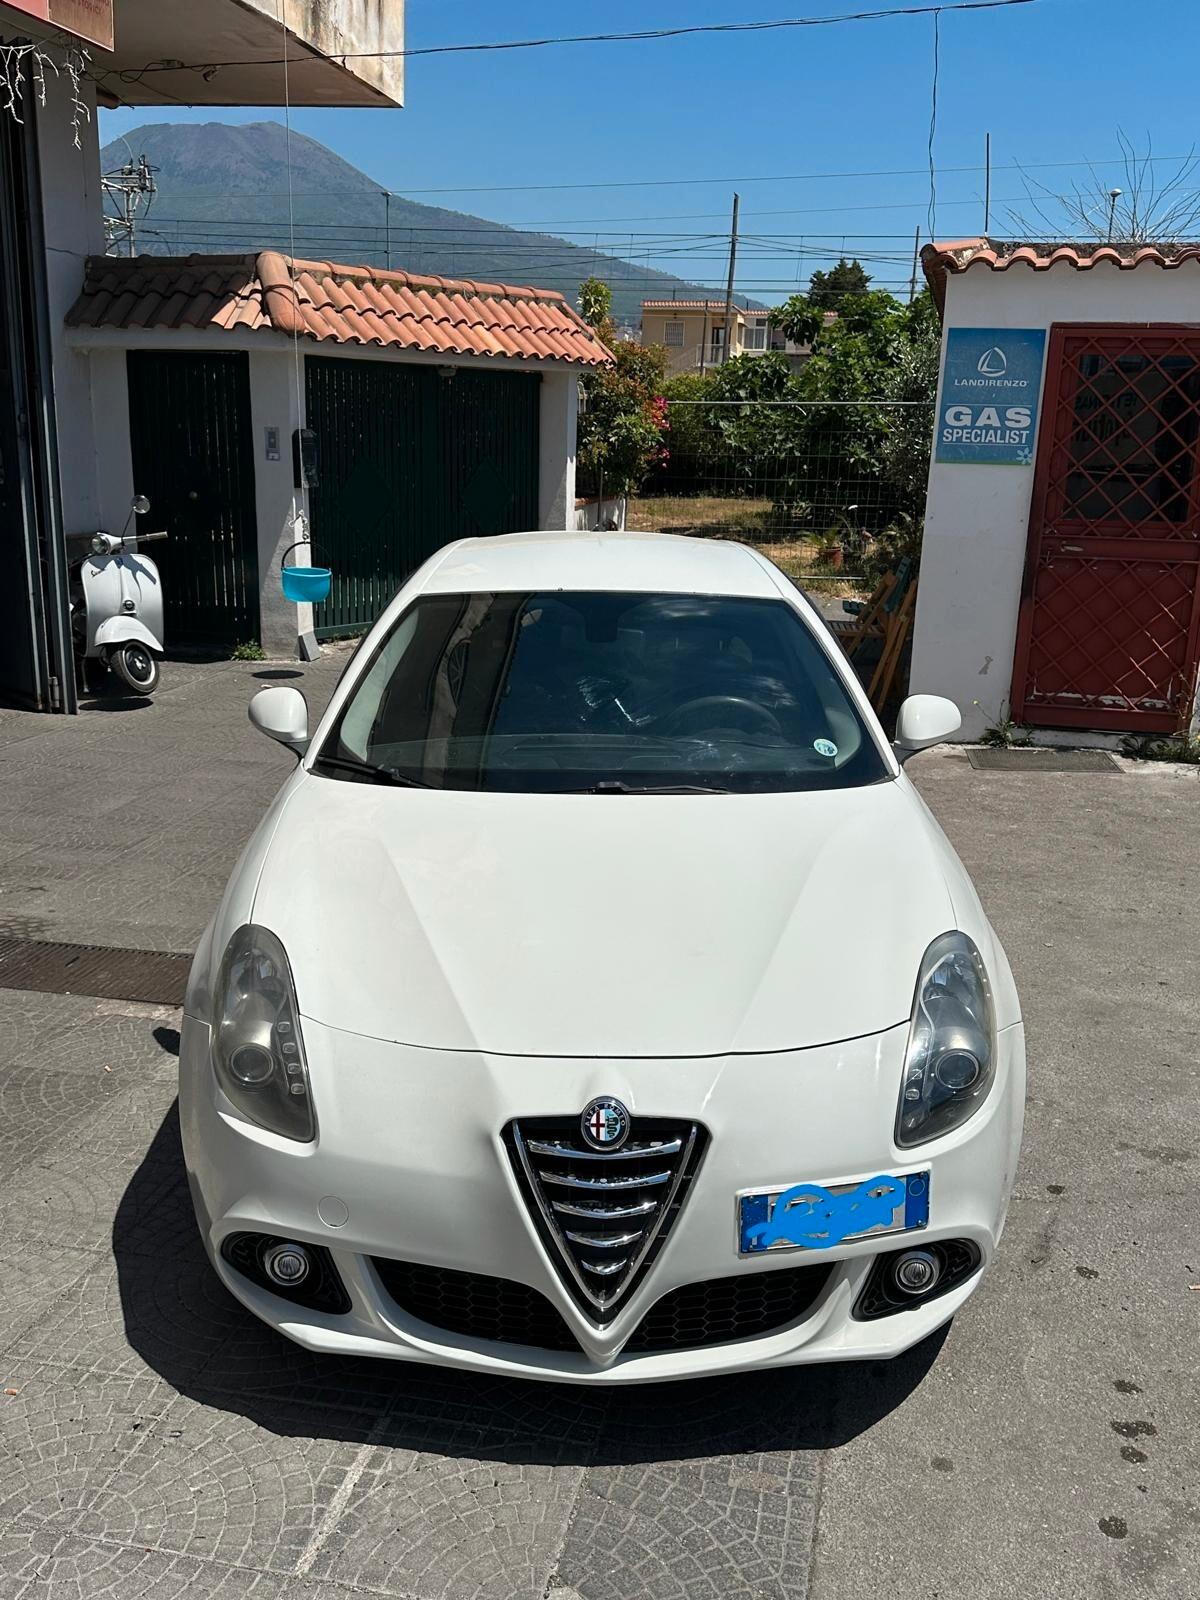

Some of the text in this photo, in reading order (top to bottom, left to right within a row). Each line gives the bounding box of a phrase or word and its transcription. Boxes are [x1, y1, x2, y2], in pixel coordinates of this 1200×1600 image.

[954, 379, 1027, 387] LANDIRENZO
[945, 406, 1031, 428] GAS
[942, 429, 1029, 443] SPECIALIST
[585, 1105, 600, 1126] ALFA
